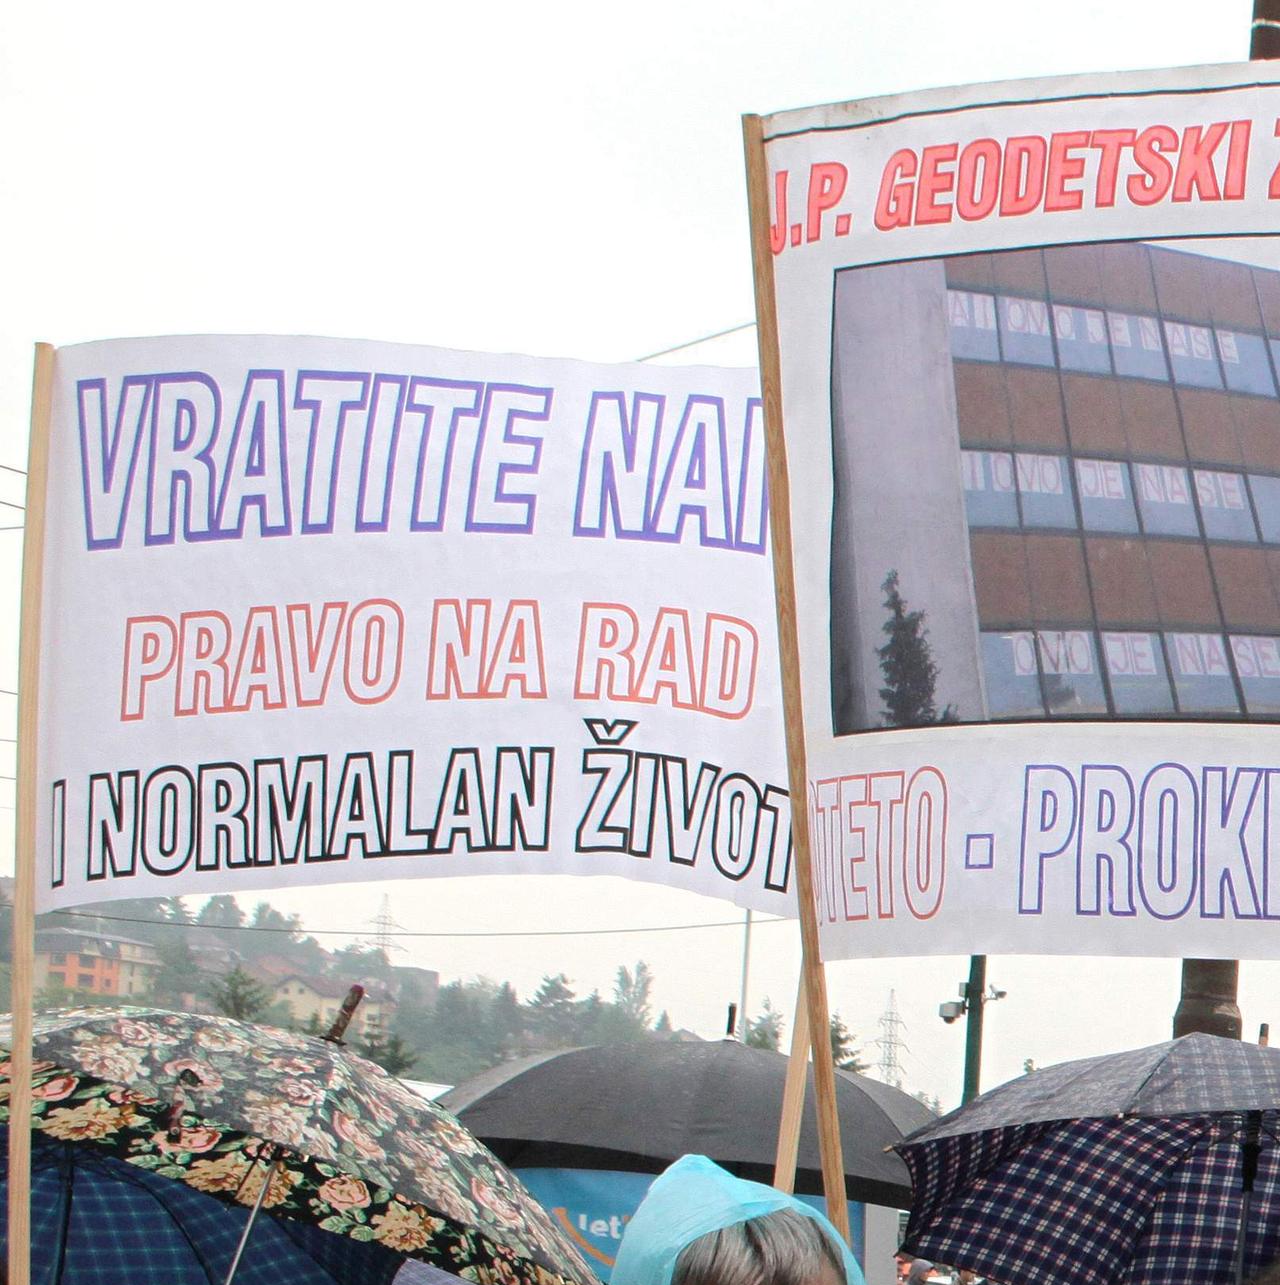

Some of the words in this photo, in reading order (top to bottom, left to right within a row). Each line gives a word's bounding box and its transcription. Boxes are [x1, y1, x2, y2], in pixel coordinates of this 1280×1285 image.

[769, 162, 852, 256] J.P.
[874, 120, 1248, 230] GEODETSKI
[77, 369, 553, 551] VRATITE
[121, 598, 404, 721] PRAVO
[426, 599, 547, 700] NA
[573, 602, 759, 719] RAD
[51, 780, 66, 888] I
[87, 747, 555, 881] NORMALAN
[575, 719, 793, 893] ŽIVOT
